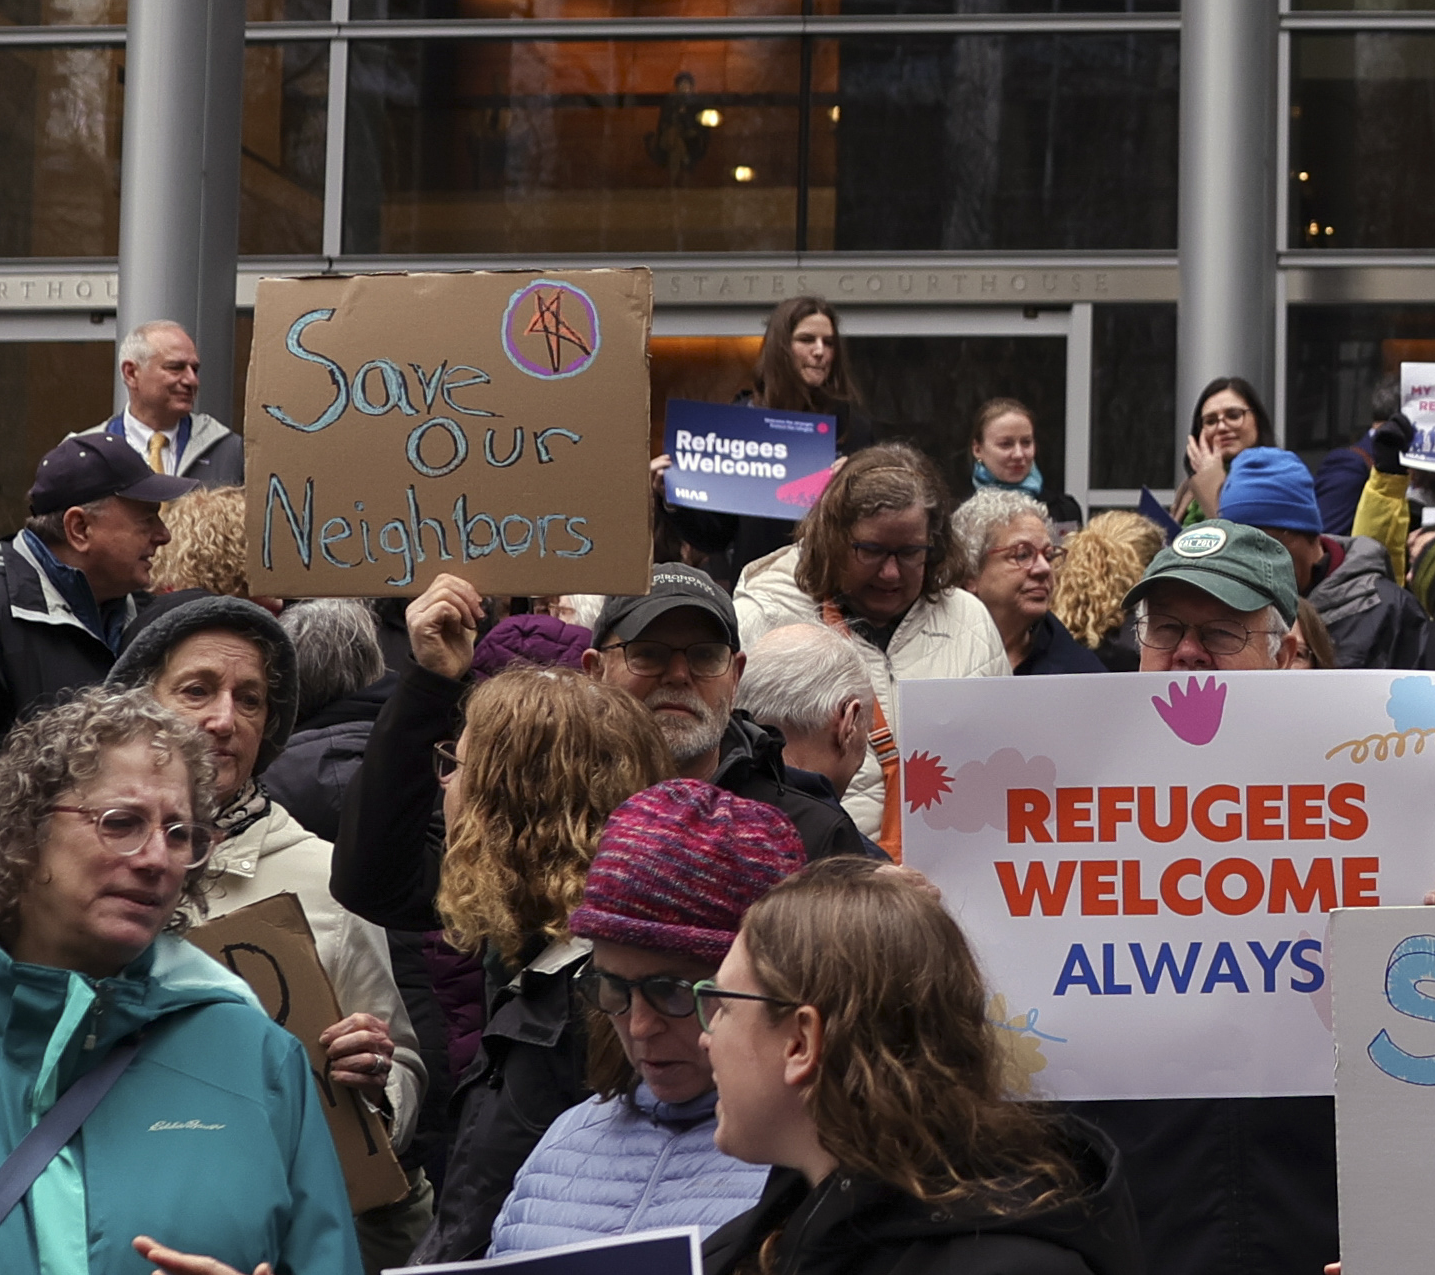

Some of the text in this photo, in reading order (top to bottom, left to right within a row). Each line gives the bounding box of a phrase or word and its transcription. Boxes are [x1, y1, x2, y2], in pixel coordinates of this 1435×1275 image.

[669, 273, 1110, 295] STATES COURTHOUSE
[261, 308, 504, 432] Save
[1411, 385, 1431, 396] MY
[406, 416, 583, 477] Our
[675, 429, 788, 459] Refugees
[675, 451, 787, 479] Welcome
[675, 487, 708, 502] HIAS
[262, 473, 593, 586] Neighbors
[1005, 782, 1370, 844] REFUGEES
[993, 856, 1381, 917] WELCOME
[1052, 939, 1326, 996] ALWAYS
